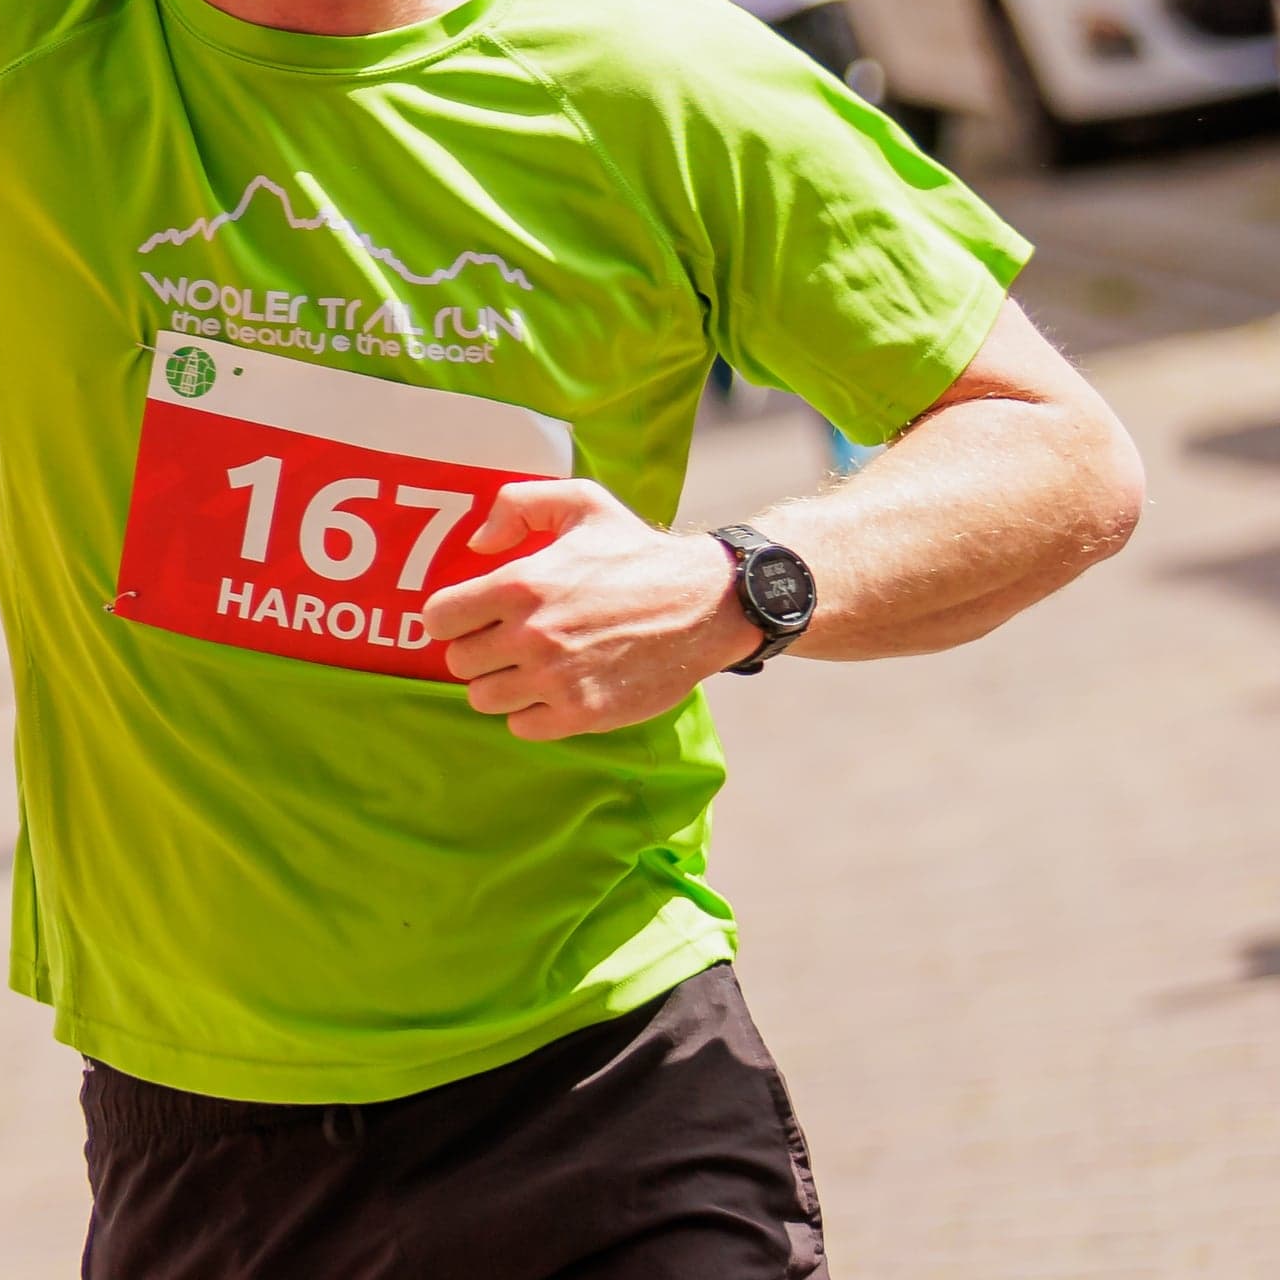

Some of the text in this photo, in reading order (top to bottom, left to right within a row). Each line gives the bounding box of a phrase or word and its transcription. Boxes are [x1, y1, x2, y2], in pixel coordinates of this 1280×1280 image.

[171, 310, 220, 337] the
[226, 317, 325, 355] beauty
[356, 331, 400, 358] the
[406, 337, 495, 365] beast
[226, 455, 475, 593] 167
[216, 577, 433, 650] HAROLD
